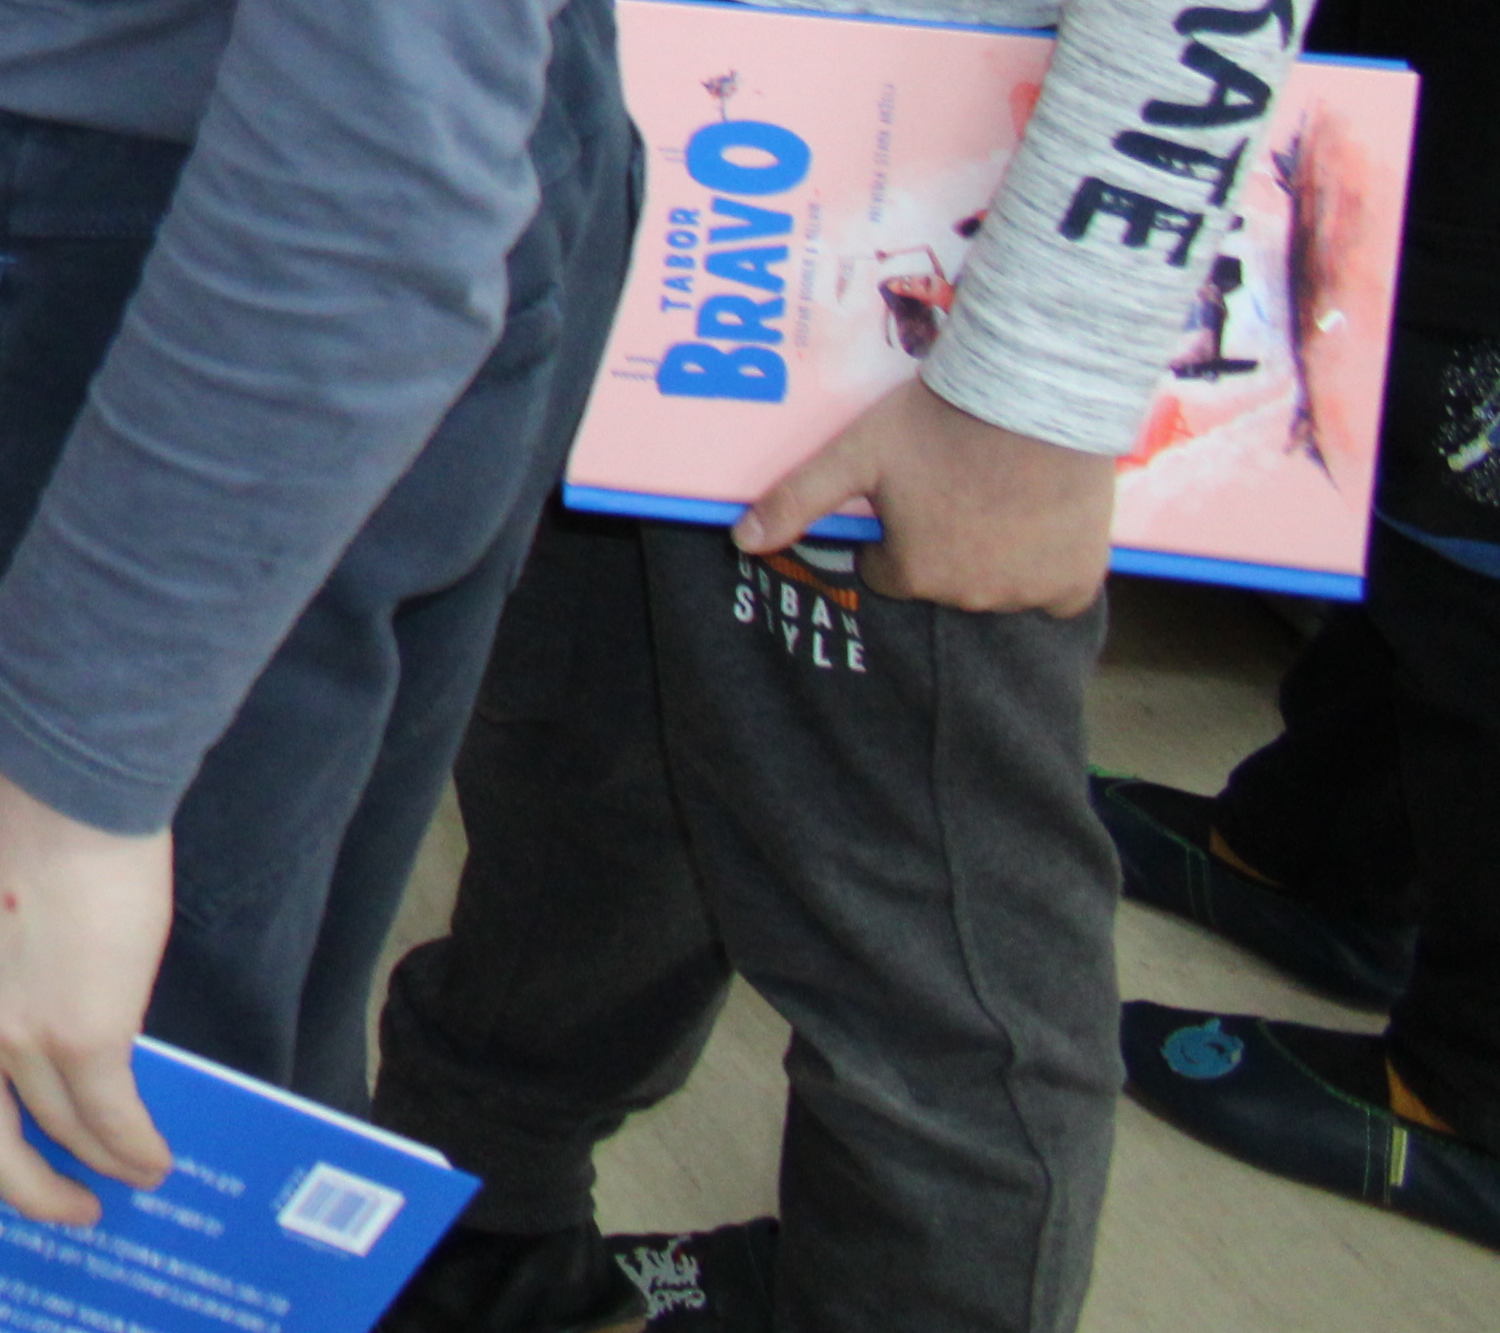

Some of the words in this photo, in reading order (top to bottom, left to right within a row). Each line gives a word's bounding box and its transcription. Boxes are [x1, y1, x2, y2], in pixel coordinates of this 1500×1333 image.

[656, 119, 811, 403] BRAVO
[661, 206, 702, 314] TABOR
[733, 583, 867, 674] SYLE
[737, 550, 862, 639] UBAN
